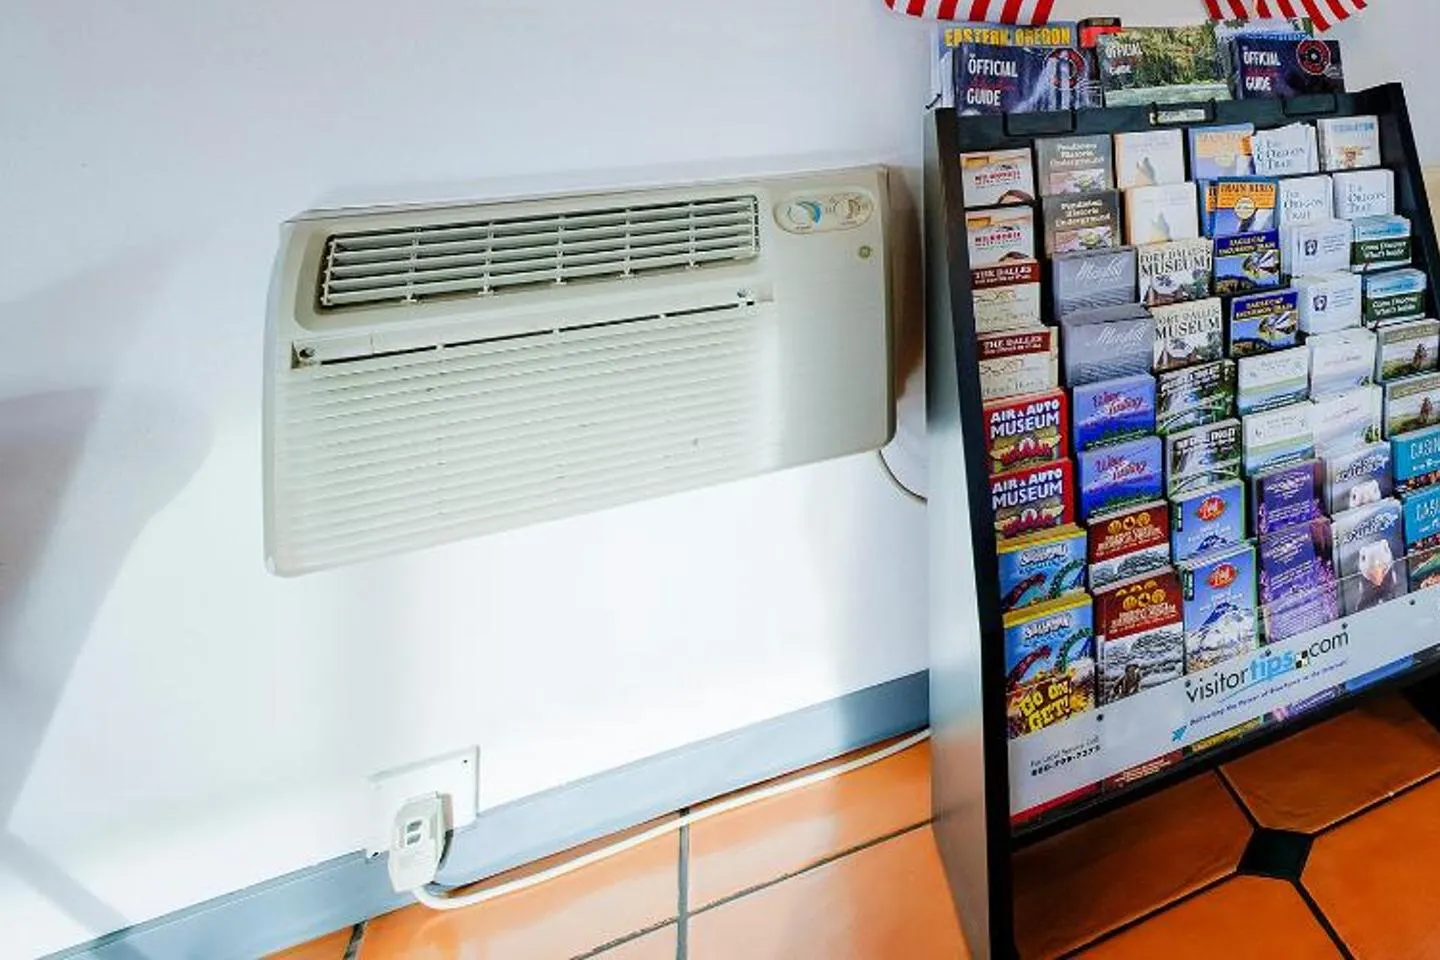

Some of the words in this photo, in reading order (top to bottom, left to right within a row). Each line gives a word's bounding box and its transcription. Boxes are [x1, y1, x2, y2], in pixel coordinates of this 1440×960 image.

[968, 58, 1018, 78] OFFICIAL
[1243, 51, 1281, 67] OFFICIAL
[1245, 75, 1272, 91] GUIDE
[967, 87, 1001, 106] GUIDE
[1140, 256, 1212, 277] MUSEUM
[1155, 316, 1221, 340] MUSEUM
[990, 410, 1016, 424] AIR
[1026, 399, 1060, 415] AUTO
[990, 411, 1060, 439] MUSEUM
[992, 479, 1017, 494] AIR
[1028, 468, 1063, 485] AUTO
[991, 480, 1063, 510] MUSEUM
